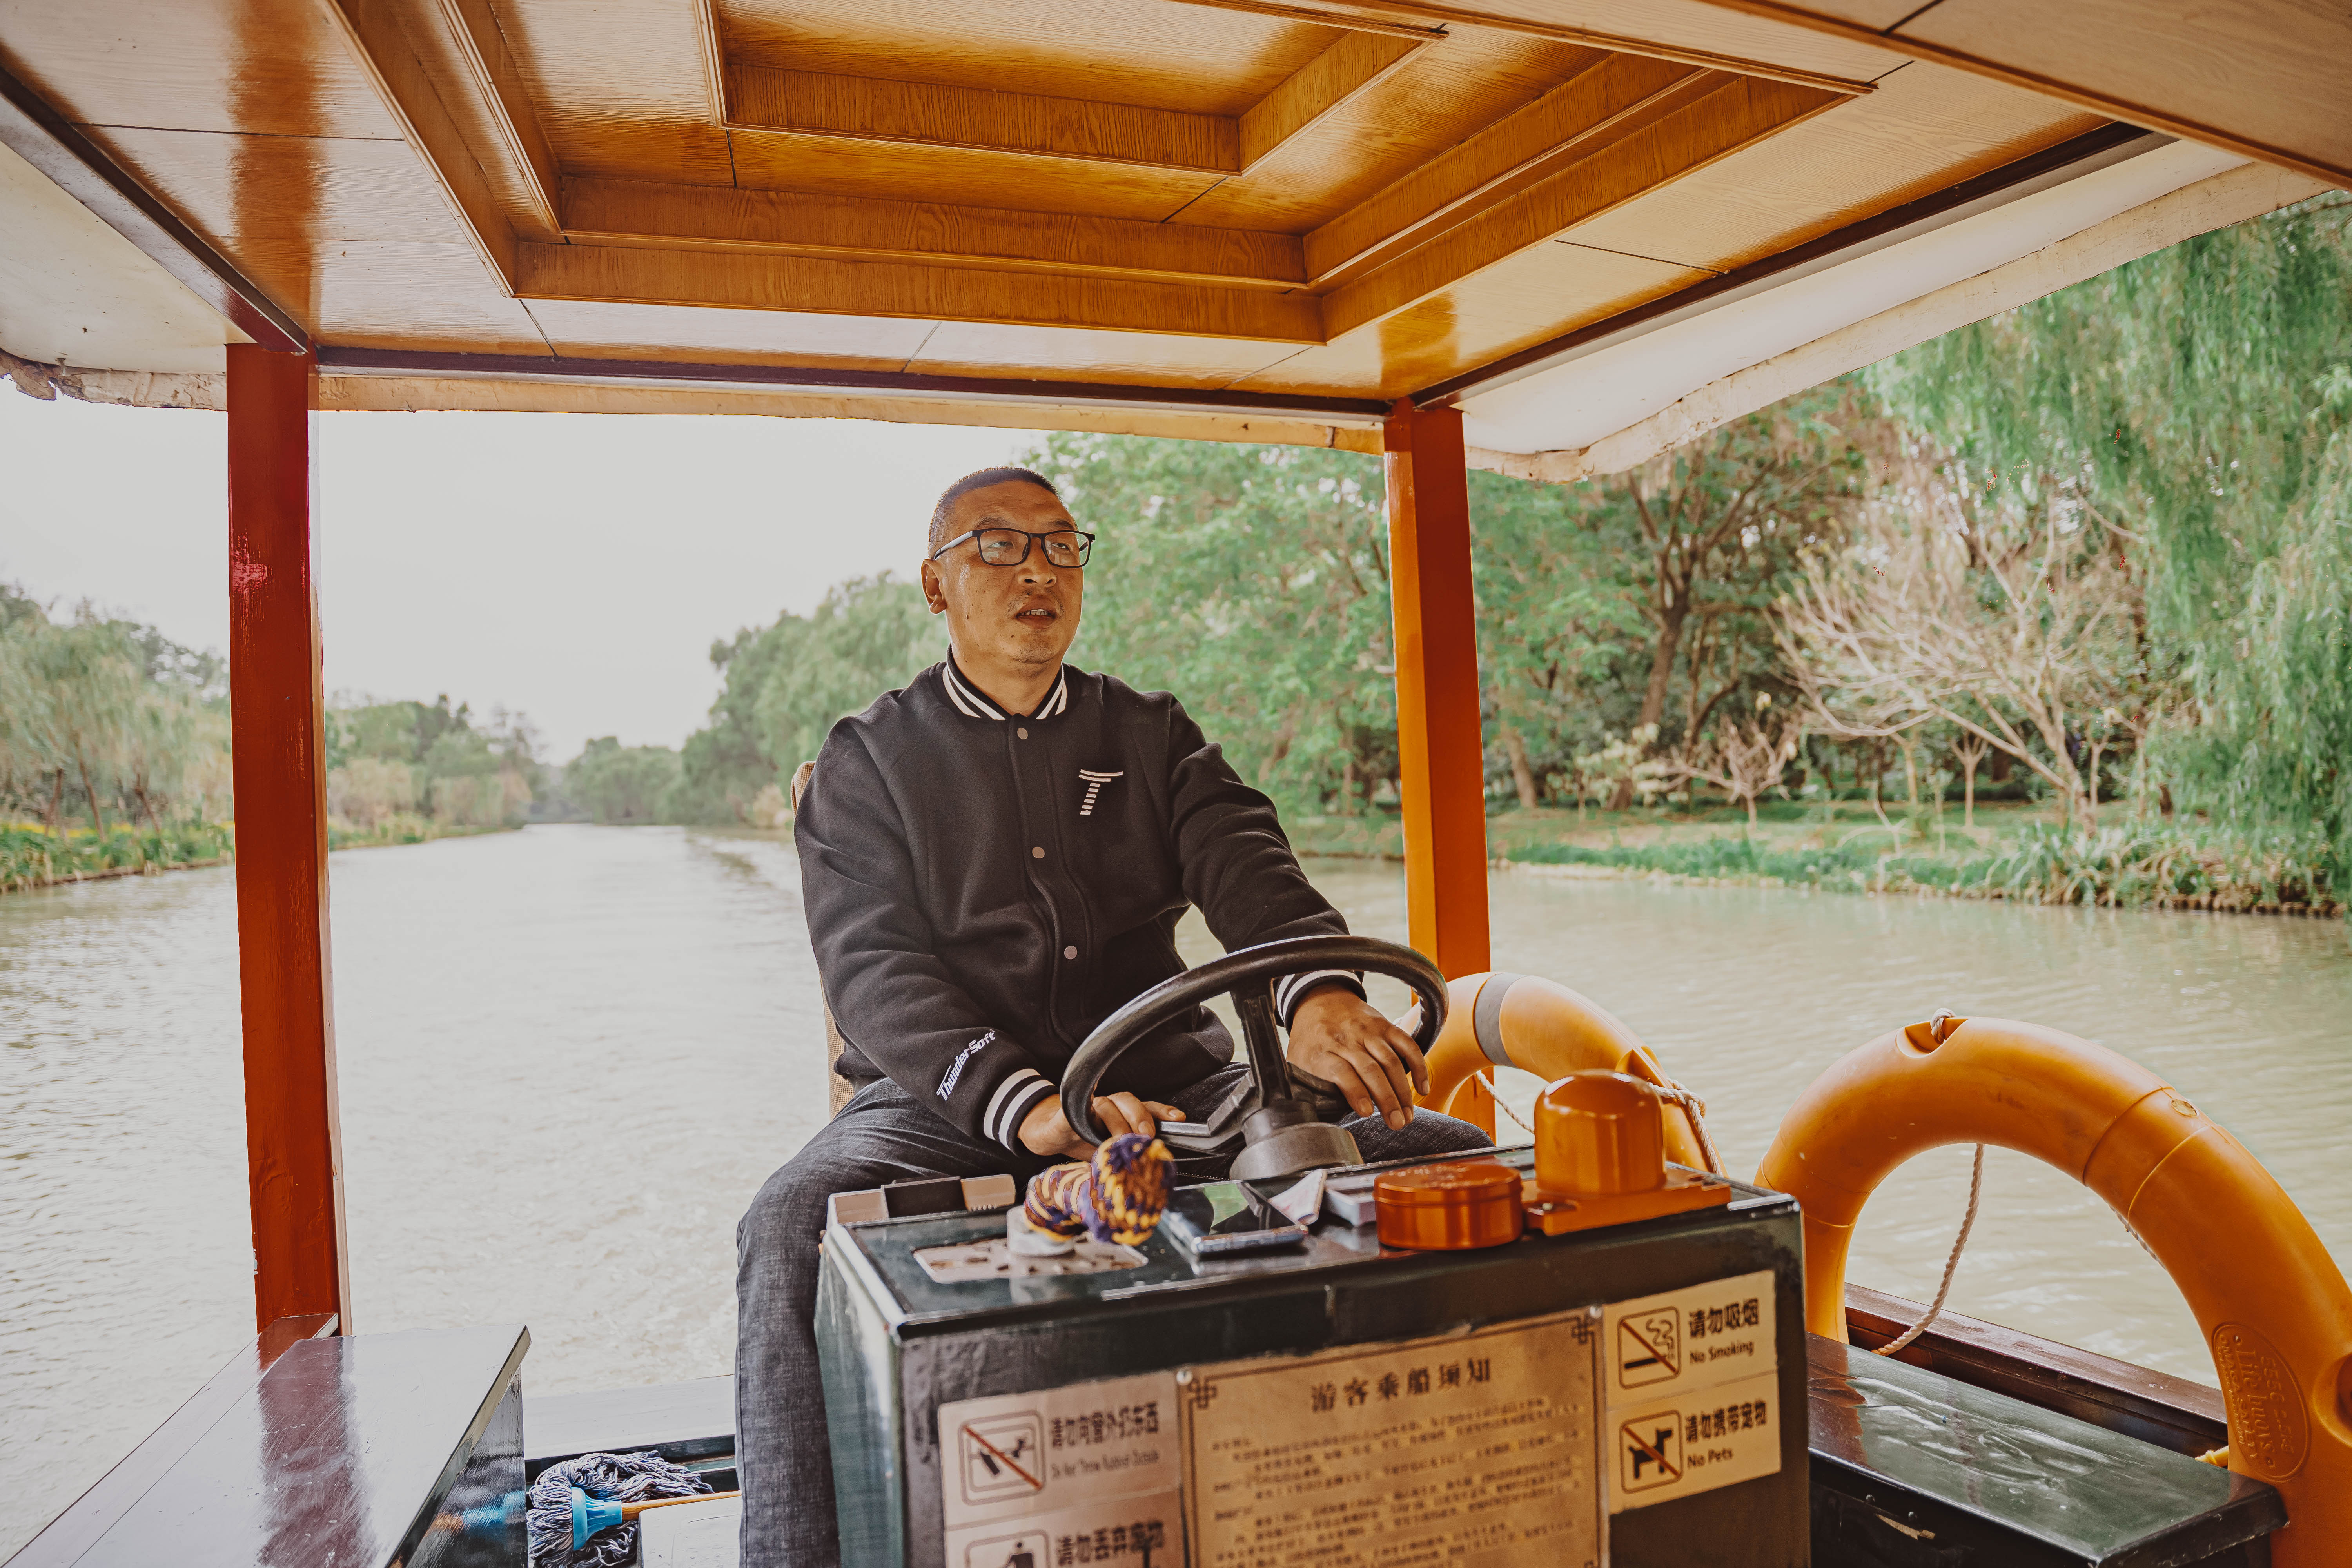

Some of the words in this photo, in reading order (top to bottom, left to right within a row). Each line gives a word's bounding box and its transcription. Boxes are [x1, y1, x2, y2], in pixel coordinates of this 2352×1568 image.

[936, 1031, 995, 1101] ThunderSoft
[1688, 1298, 1760, 1338] 请勿吸烟
[1690, 1351, 1706, 1364] No
[1708, 1341, 1754, 1362] Smoking
[1311, 1357, 1490, 1412] 游客乘船须知
[1686, 1400, 1766, 1443] 请勿携带宠物
[1687, 1455, 1705, 1469] No
[1708, 1448, 1733, 1463] Pets
